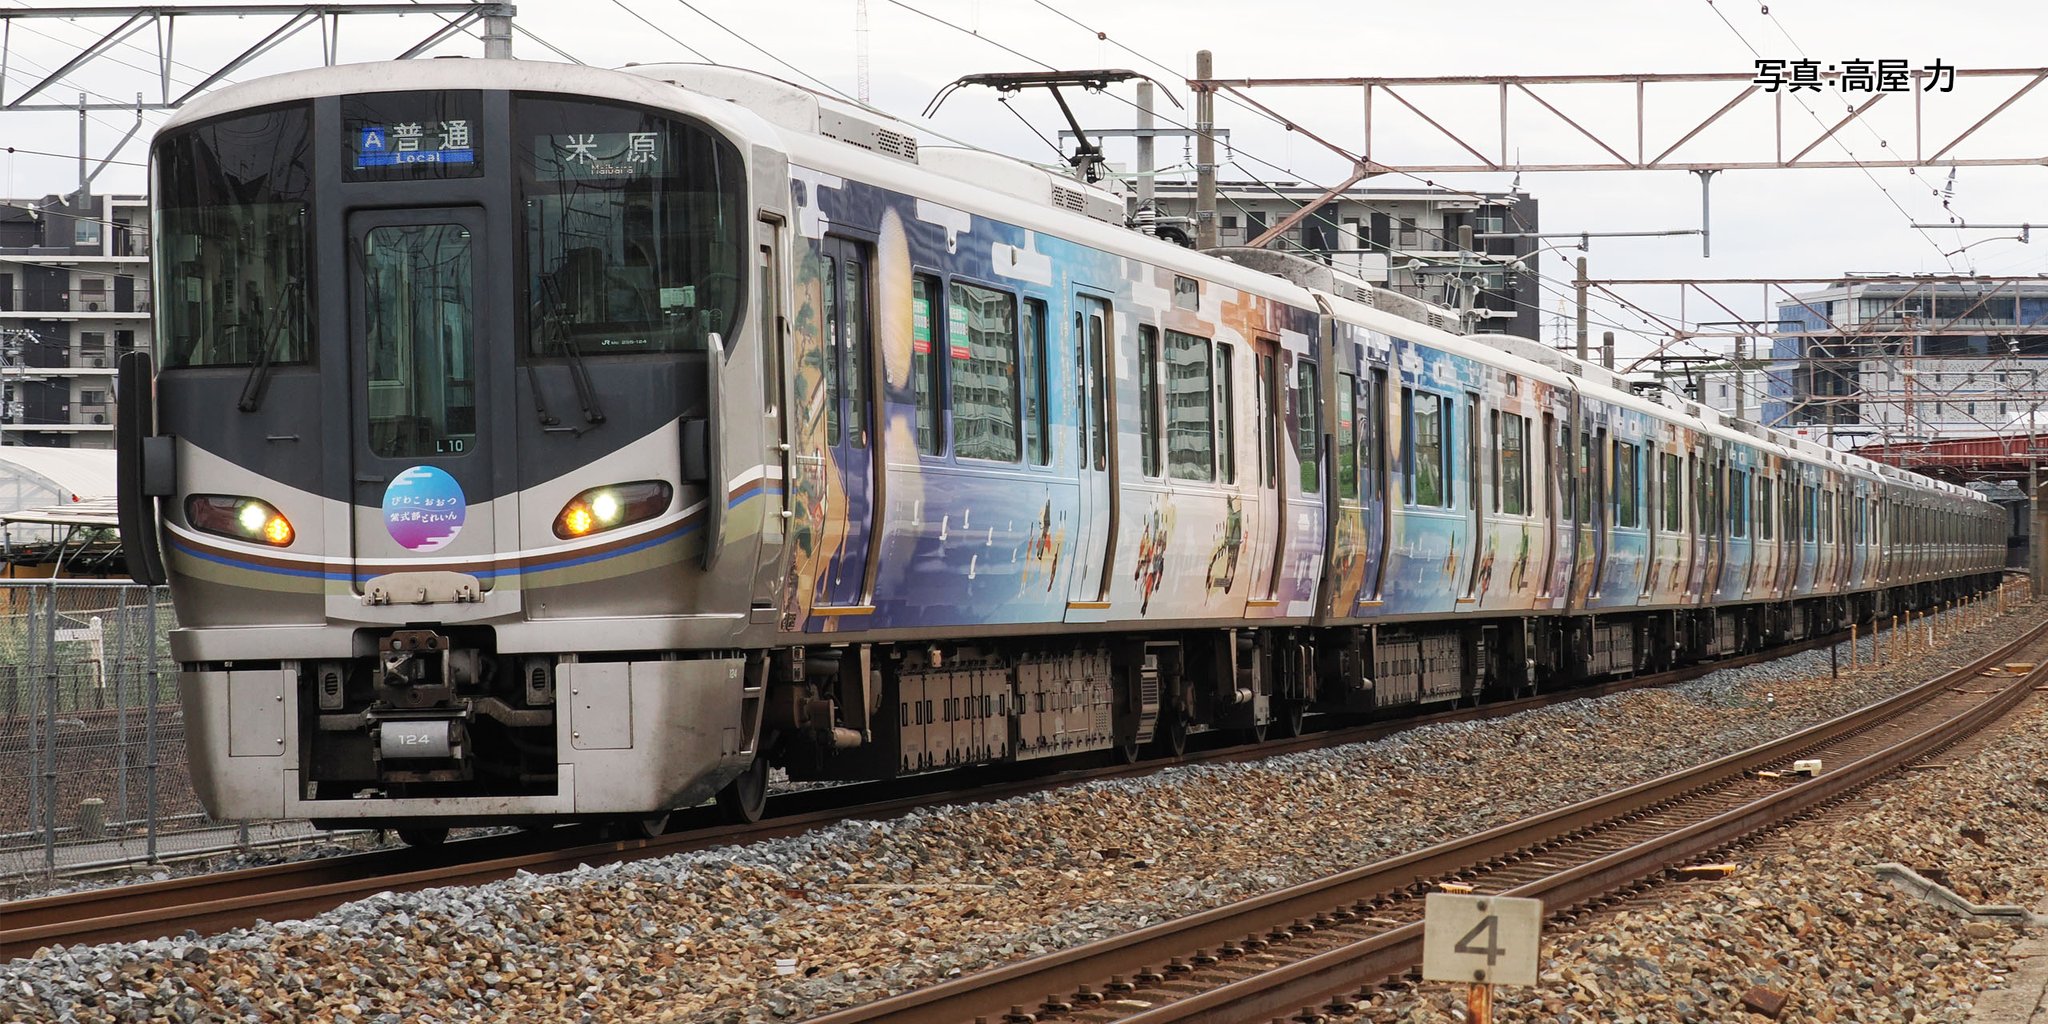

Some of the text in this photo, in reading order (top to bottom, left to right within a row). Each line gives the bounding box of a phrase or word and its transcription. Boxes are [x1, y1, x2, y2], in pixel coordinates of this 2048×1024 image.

[364, 131, 382, 148] A
[392, 120, 470, 152] 普通
[565, 132, 658, 164] 米原
[396, 152, 440, 164] Local
[436, 440, 464, 452] L 10
[398, 734, 430, 745] 124
[1454, 915, 1506, 966] 4
